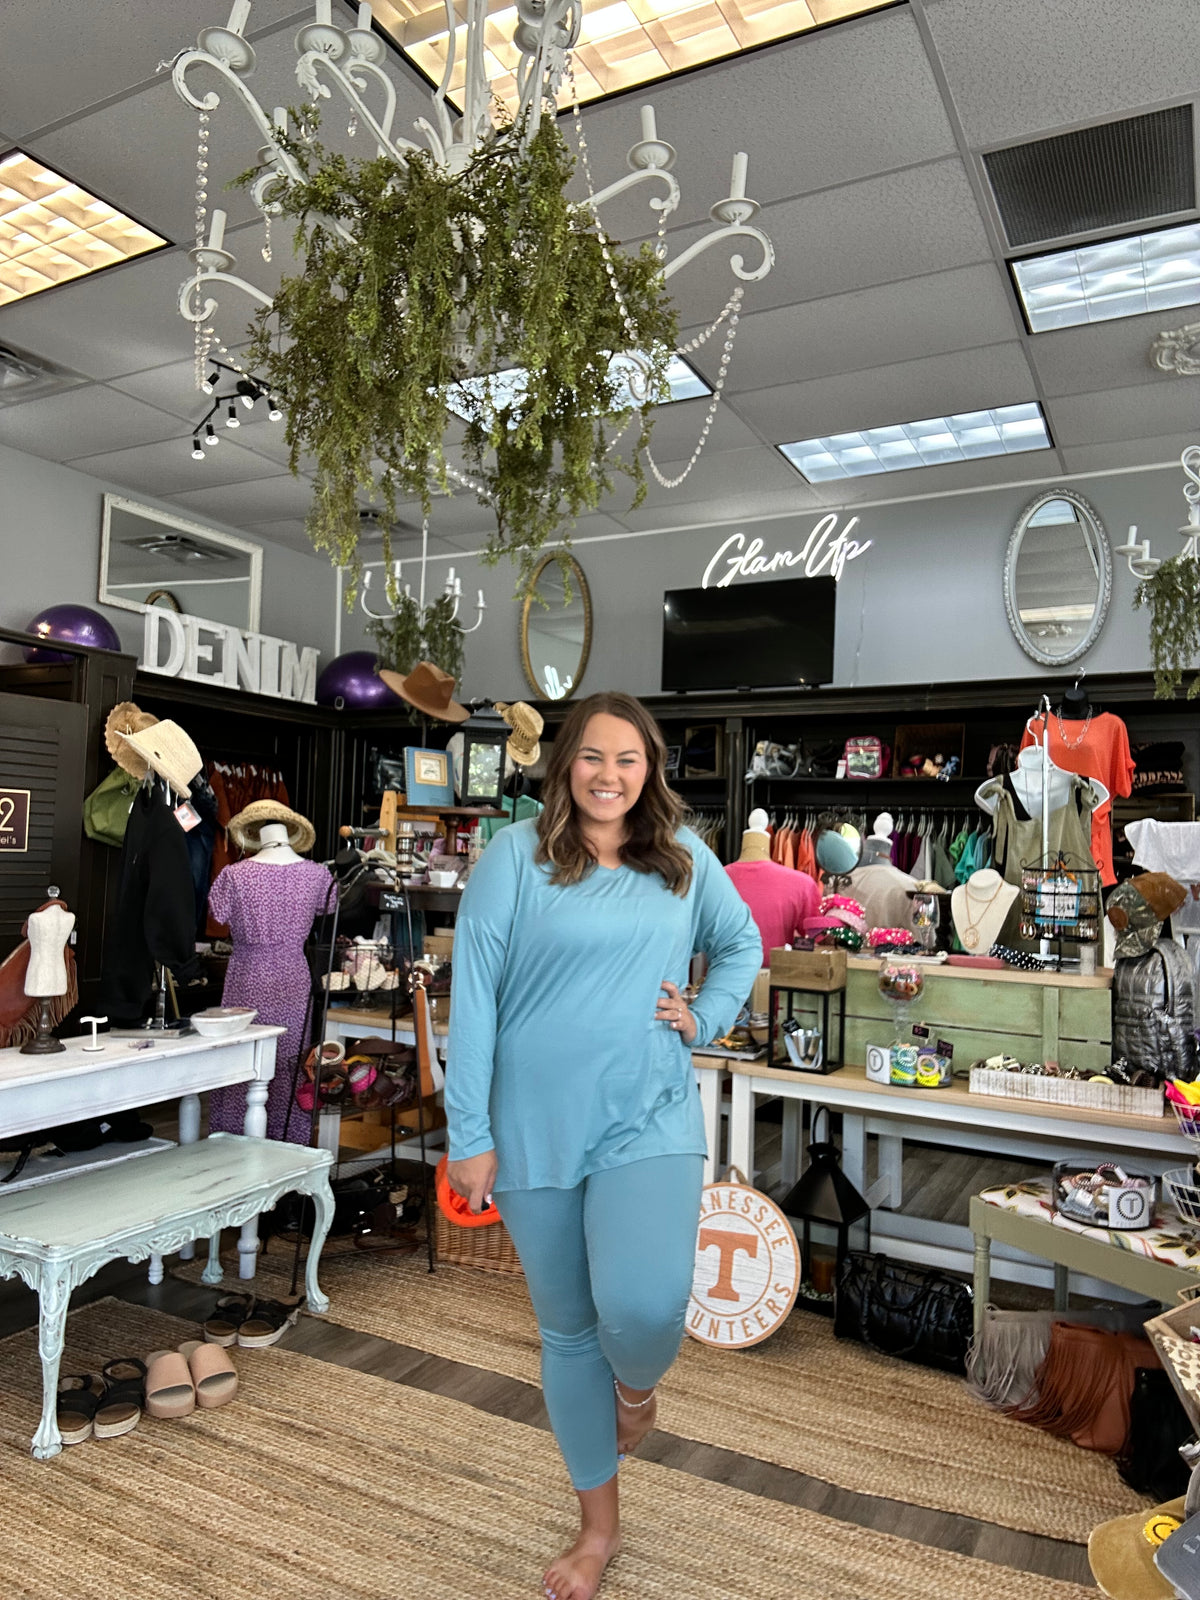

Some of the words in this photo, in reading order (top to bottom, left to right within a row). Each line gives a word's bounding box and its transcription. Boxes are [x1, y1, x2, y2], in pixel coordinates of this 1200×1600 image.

[701, 532, 805, 590] Glam
[805, 513, 873, 582] Up
[137, 604, 321, 706] DENIM
[698, 1227, 759, 1302] T
